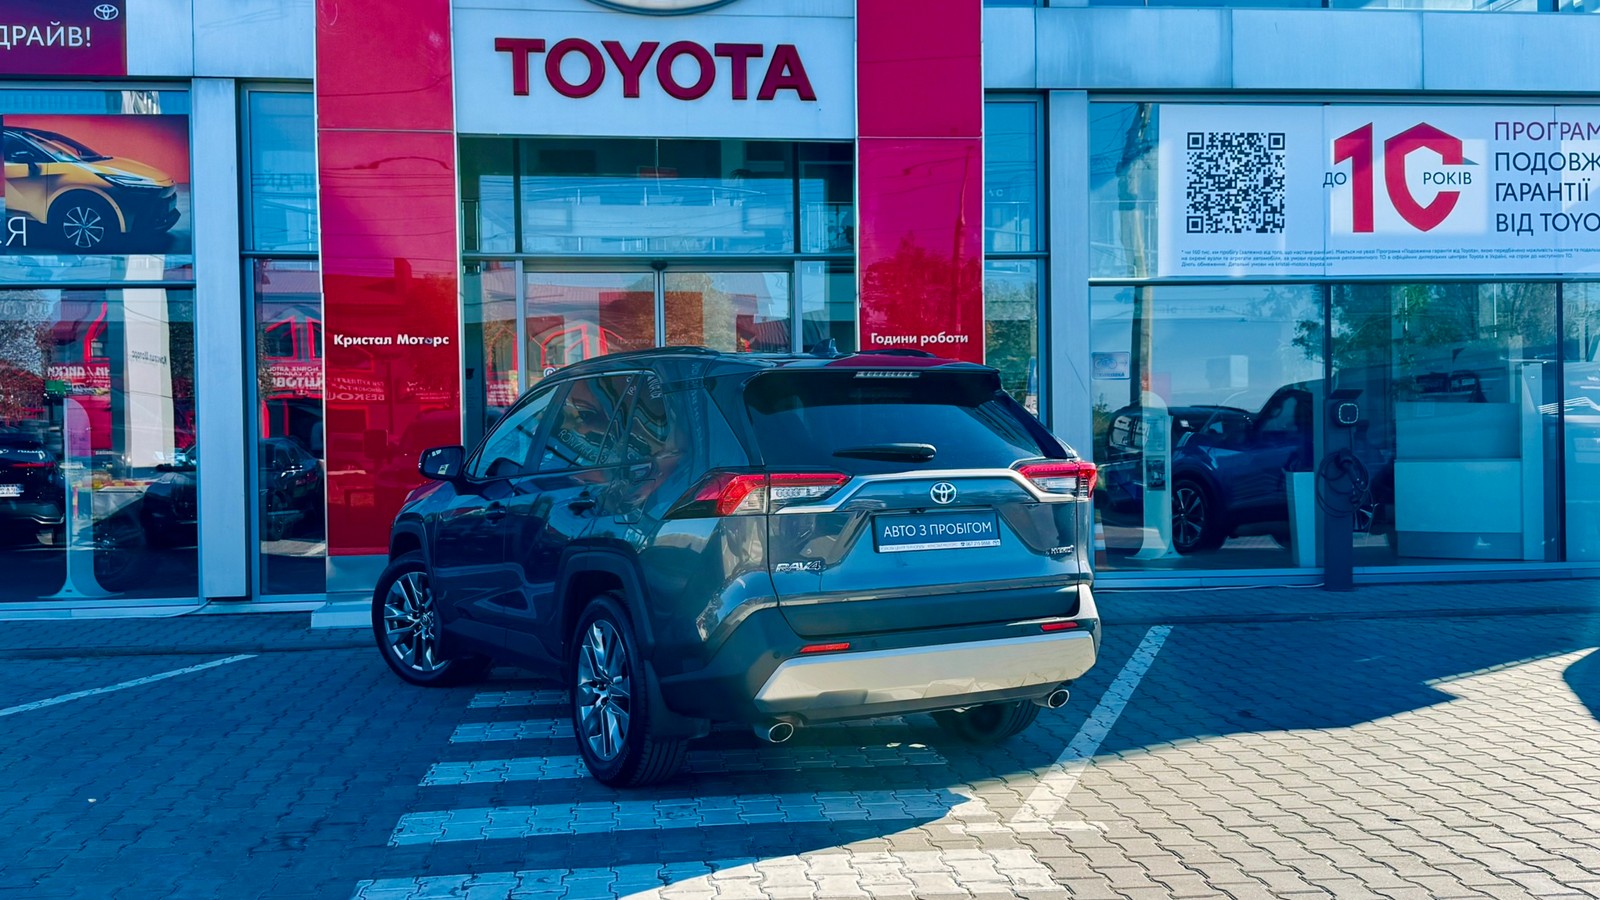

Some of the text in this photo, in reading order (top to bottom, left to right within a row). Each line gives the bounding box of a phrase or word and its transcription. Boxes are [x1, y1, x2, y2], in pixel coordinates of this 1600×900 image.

[494, 37, 817, 101] TOYOTA
[1495, 152, 1600, 175] ПОДОВЖ
[1323, 171, 1347, 188] ДО
[1423, 171, 1472, 185] РОКІВ
[1495, 177, 1591, 202] ГАРАНТІЇ
[1496, 213, 1534, 236] ВІД
[334, 334, 449, 348] Кристал Моторс
[871, 331, 968, 346] Години роботи
[883, 525, 916, 538] АВТО
[929, 521, 992, 535] ПРОБІГОМ
[775, 560, 821, 572] RAV4
